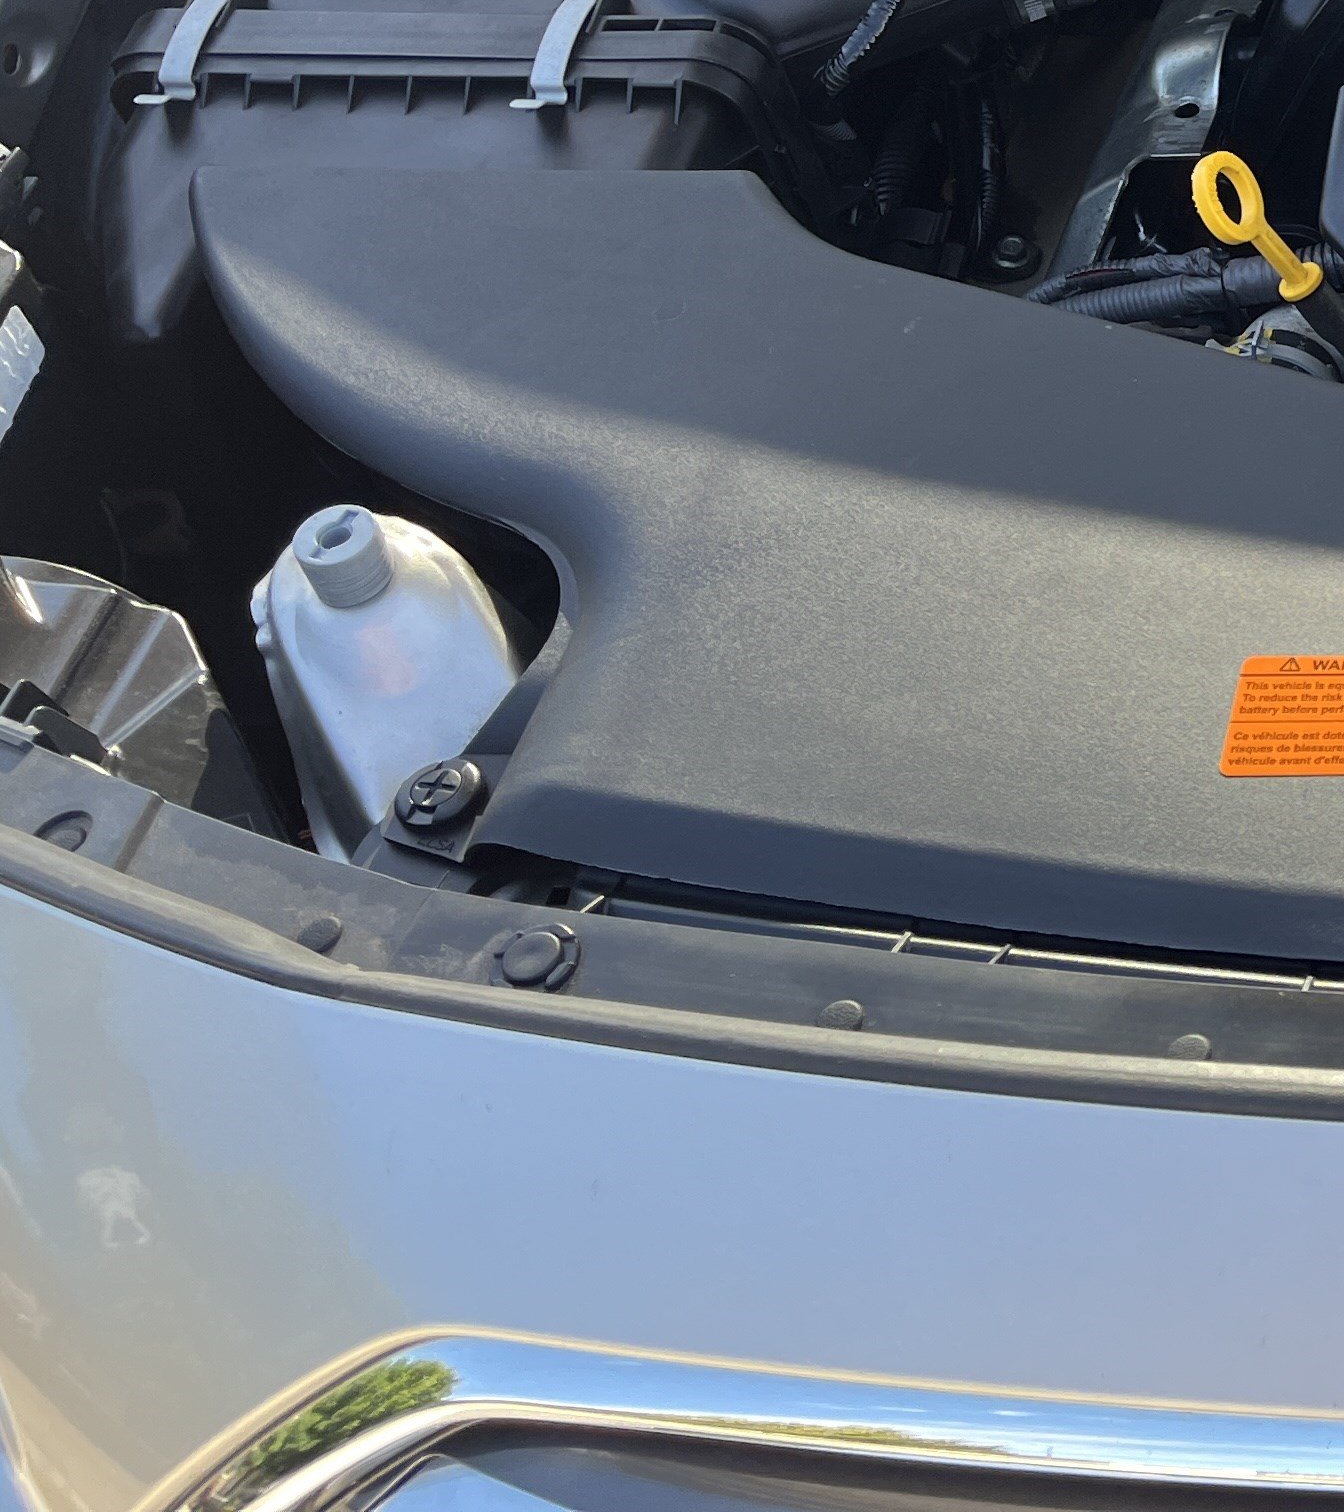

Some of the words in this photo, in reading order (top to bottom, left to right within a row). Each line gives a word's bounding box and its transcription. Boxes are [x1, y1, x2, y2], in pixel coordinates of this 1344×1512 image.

[1246, 681, 1269, 690] This
[1272, 681, 1312, 690] vehicle
[1315, 681, 1325, 690] is
[1242, 693, 1257, 702] To
[1259, 693, 1298, 702] reduce
[1301, 693, 1318, 702] the
[1321, 693, 1342, 702] risk
[1239, 705, 1279, 716] battery
[1282, 704, 1319, 714] before
[1233, 731, 1250, 740] Ce
[1252, 730, 1299, 740] véhicule
[1302, 731, 1320, 740] est
[1230, 744, 1274, 754] risques
[1276, 744, 1291, 753] de
[1227, 756, 1276, 766] véhicule
[1279, 757, 1310, 765] avant
